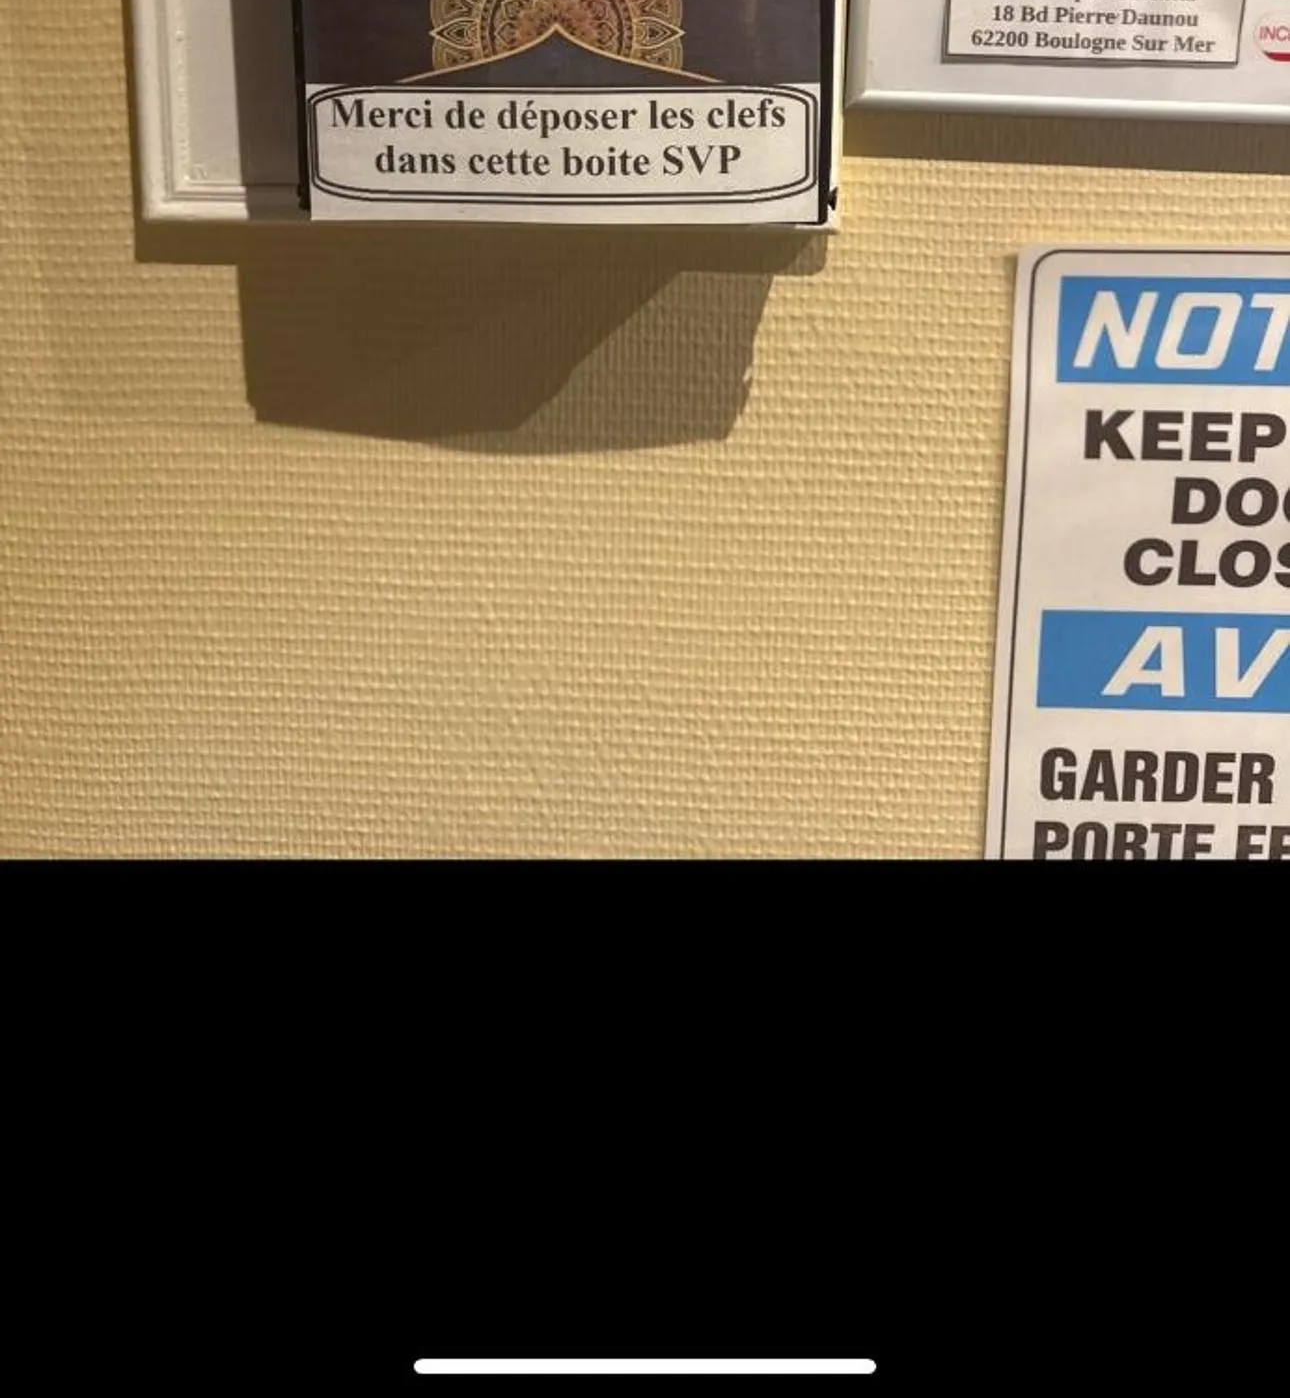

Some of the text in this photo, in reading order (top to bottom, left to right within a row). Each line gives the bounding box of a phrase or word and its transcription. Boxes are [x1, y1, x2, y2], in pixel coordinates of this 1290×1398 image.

[992, 5, 1199, 27] 18 Bd Pierre Daunou
[1259, 25, 1290, 42] INC
[971, 29, 1215, 54] 62200 Boulogne Sur Mer
[330, 97, 787, 139] Merci de déposer les clefs
[374, 144, 742, 177] dans cette boite SVP
[1084, 409, 1287, 463] KEEP
[1170, 476, 1290, 529] DO
[1100, 625, 1290, 699] AV
[1039, 746, 1275, 804] GARDER
[1032, 820, 1215, 860] PORTE
